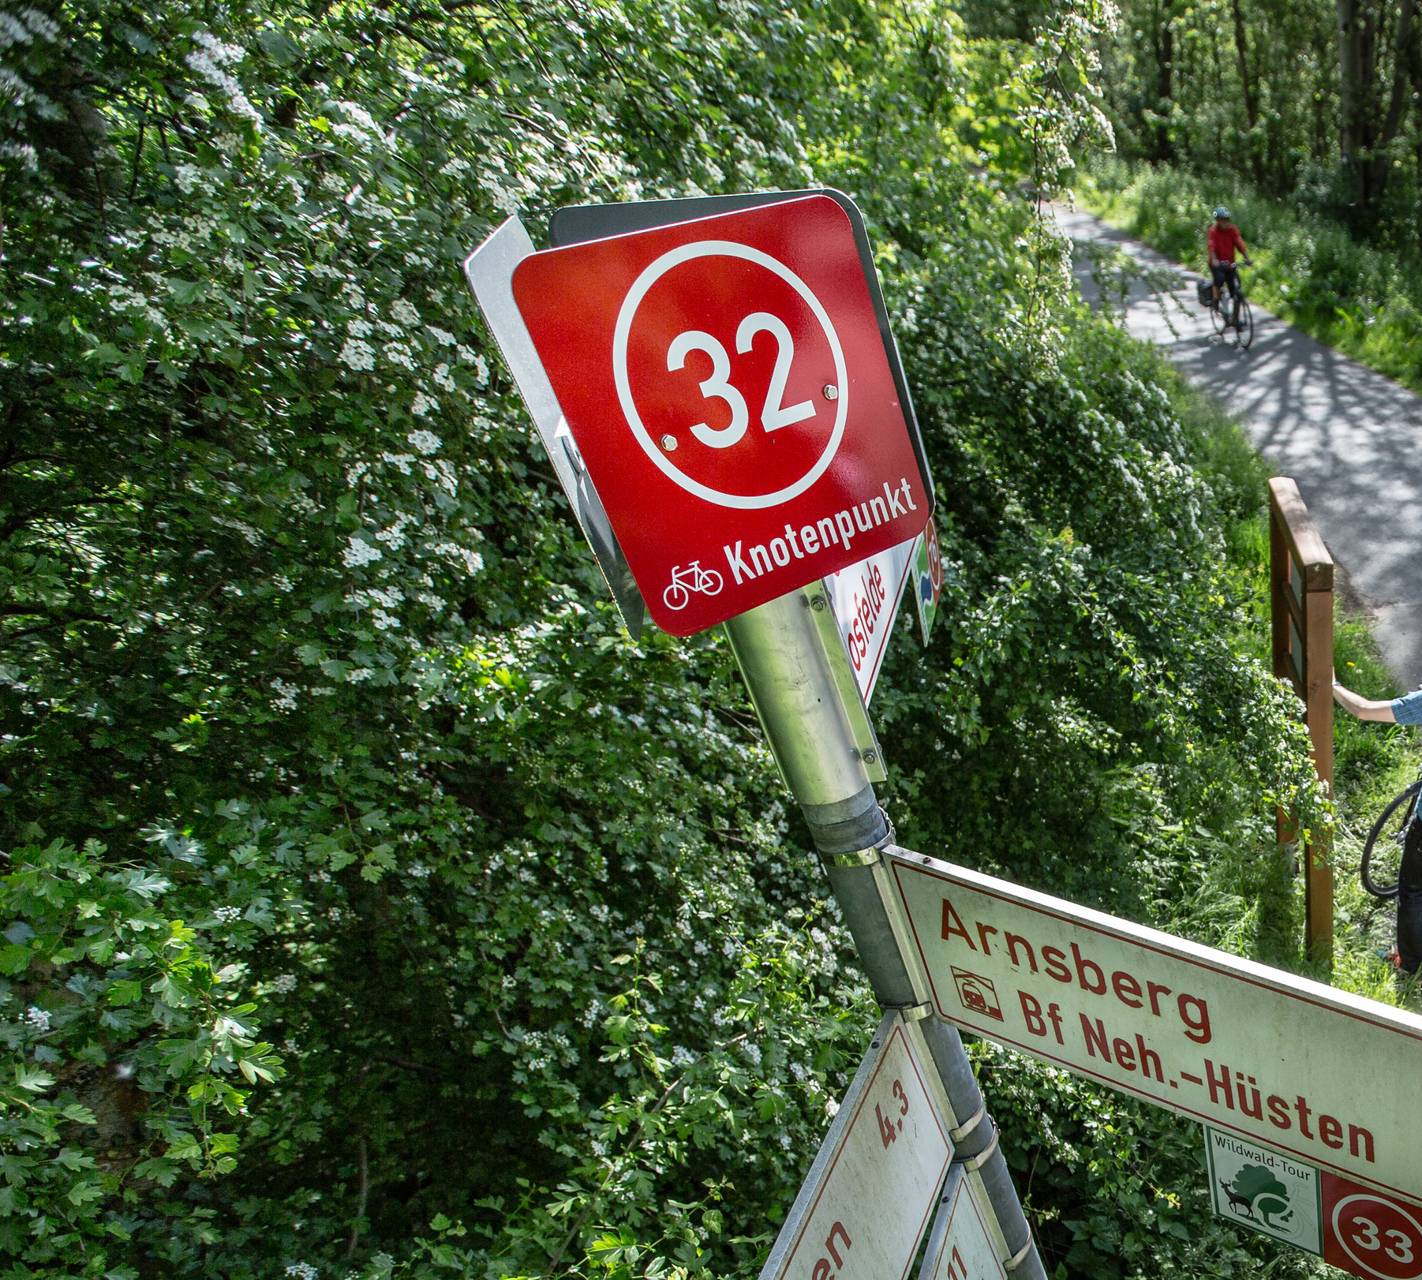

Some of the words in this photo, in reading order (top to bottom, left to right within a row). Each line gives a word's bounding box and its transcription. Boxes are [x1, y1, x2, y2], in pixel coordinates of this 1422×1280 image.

[666, 311, 817, 449] 32
[723, 477, 917, 586] Knotenpunkt
[941, 897, 1212, 1044] Arnsberg
[1017, 990, 1065, 1045] Bf
[1079, 1012, 1375, 1163] Neh.-Hüsten
[1214, 1134, 1311, 1182] Wildwald-Tour
[1352, 1216, 1415, 1264] 33
